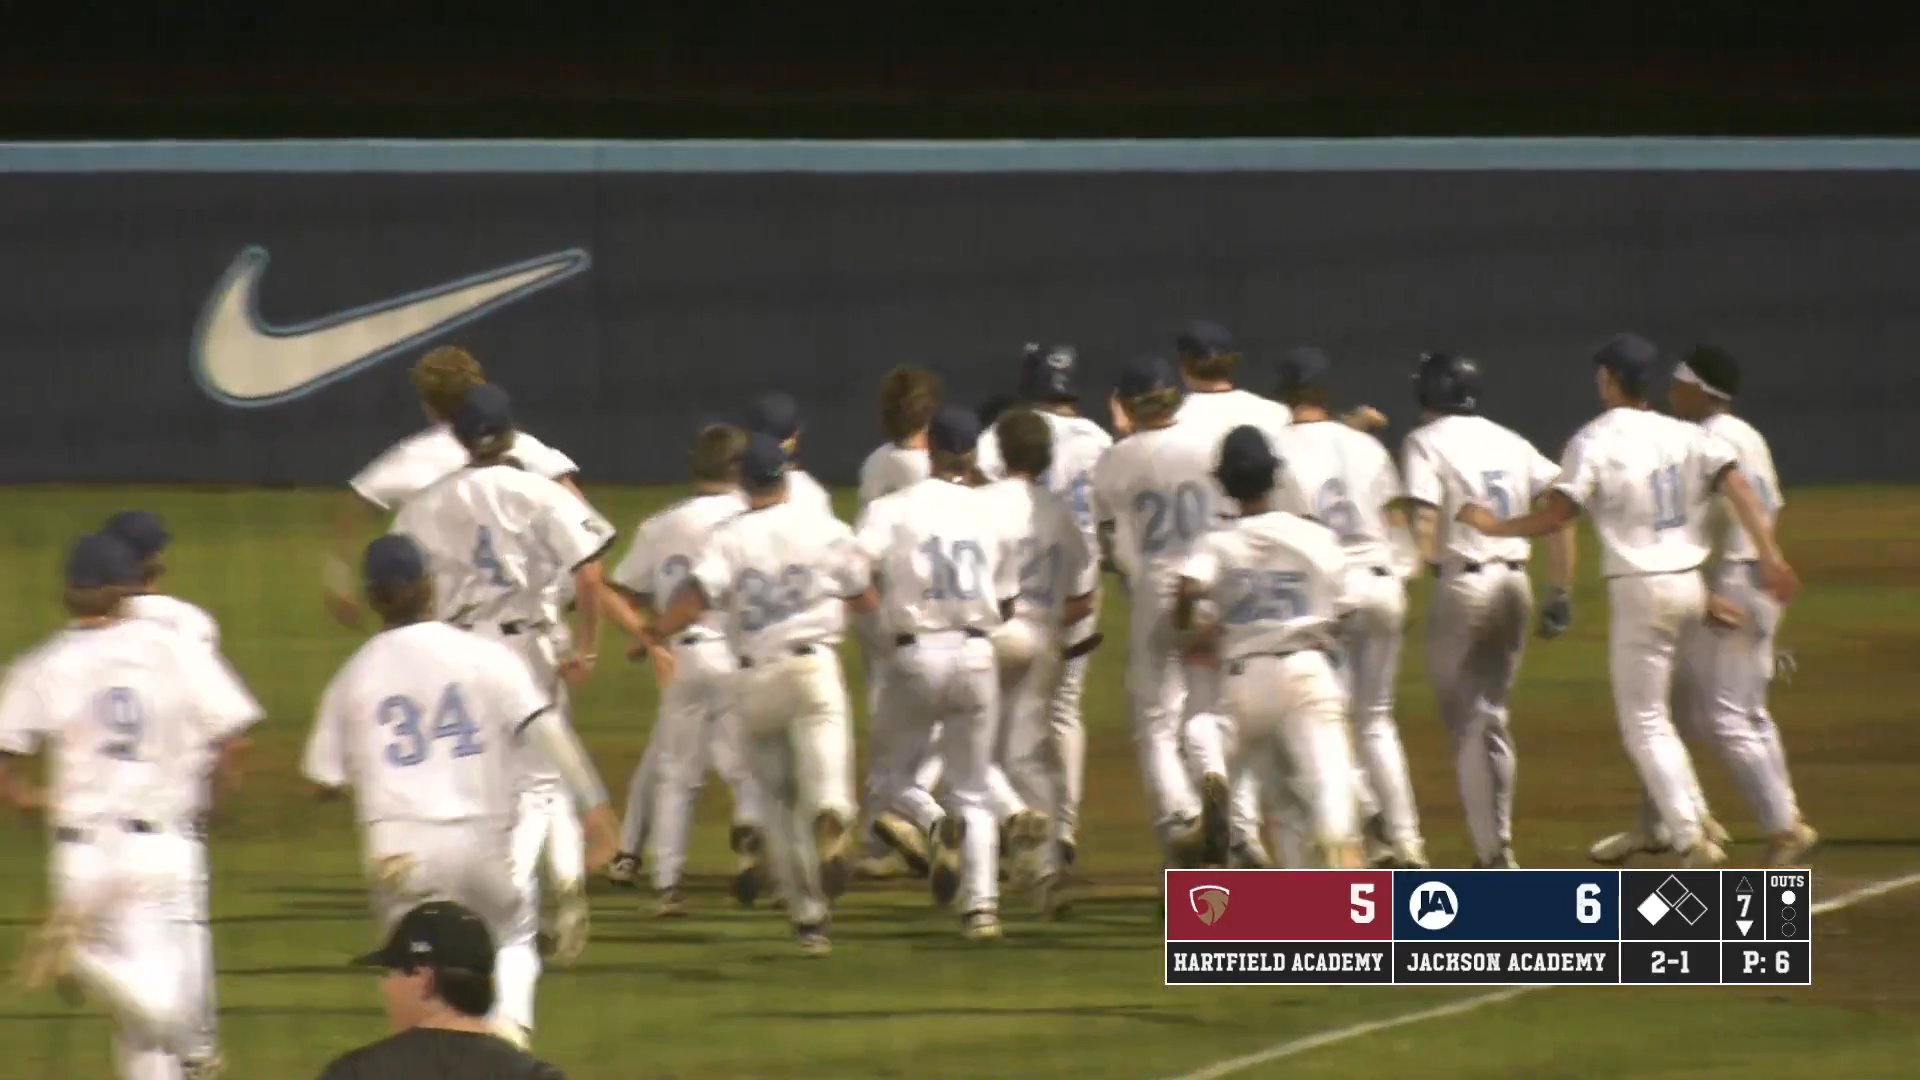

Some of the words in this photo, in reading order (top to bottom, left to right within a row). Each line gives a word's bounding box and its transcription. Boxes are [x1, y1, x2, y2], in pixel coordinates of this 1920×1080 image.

[1133, 481, 1207, 550] 20
[919, 535, 988, 600] 10
[93, 686, 145, 761] 9
[378, 682, 486, 768] 34
